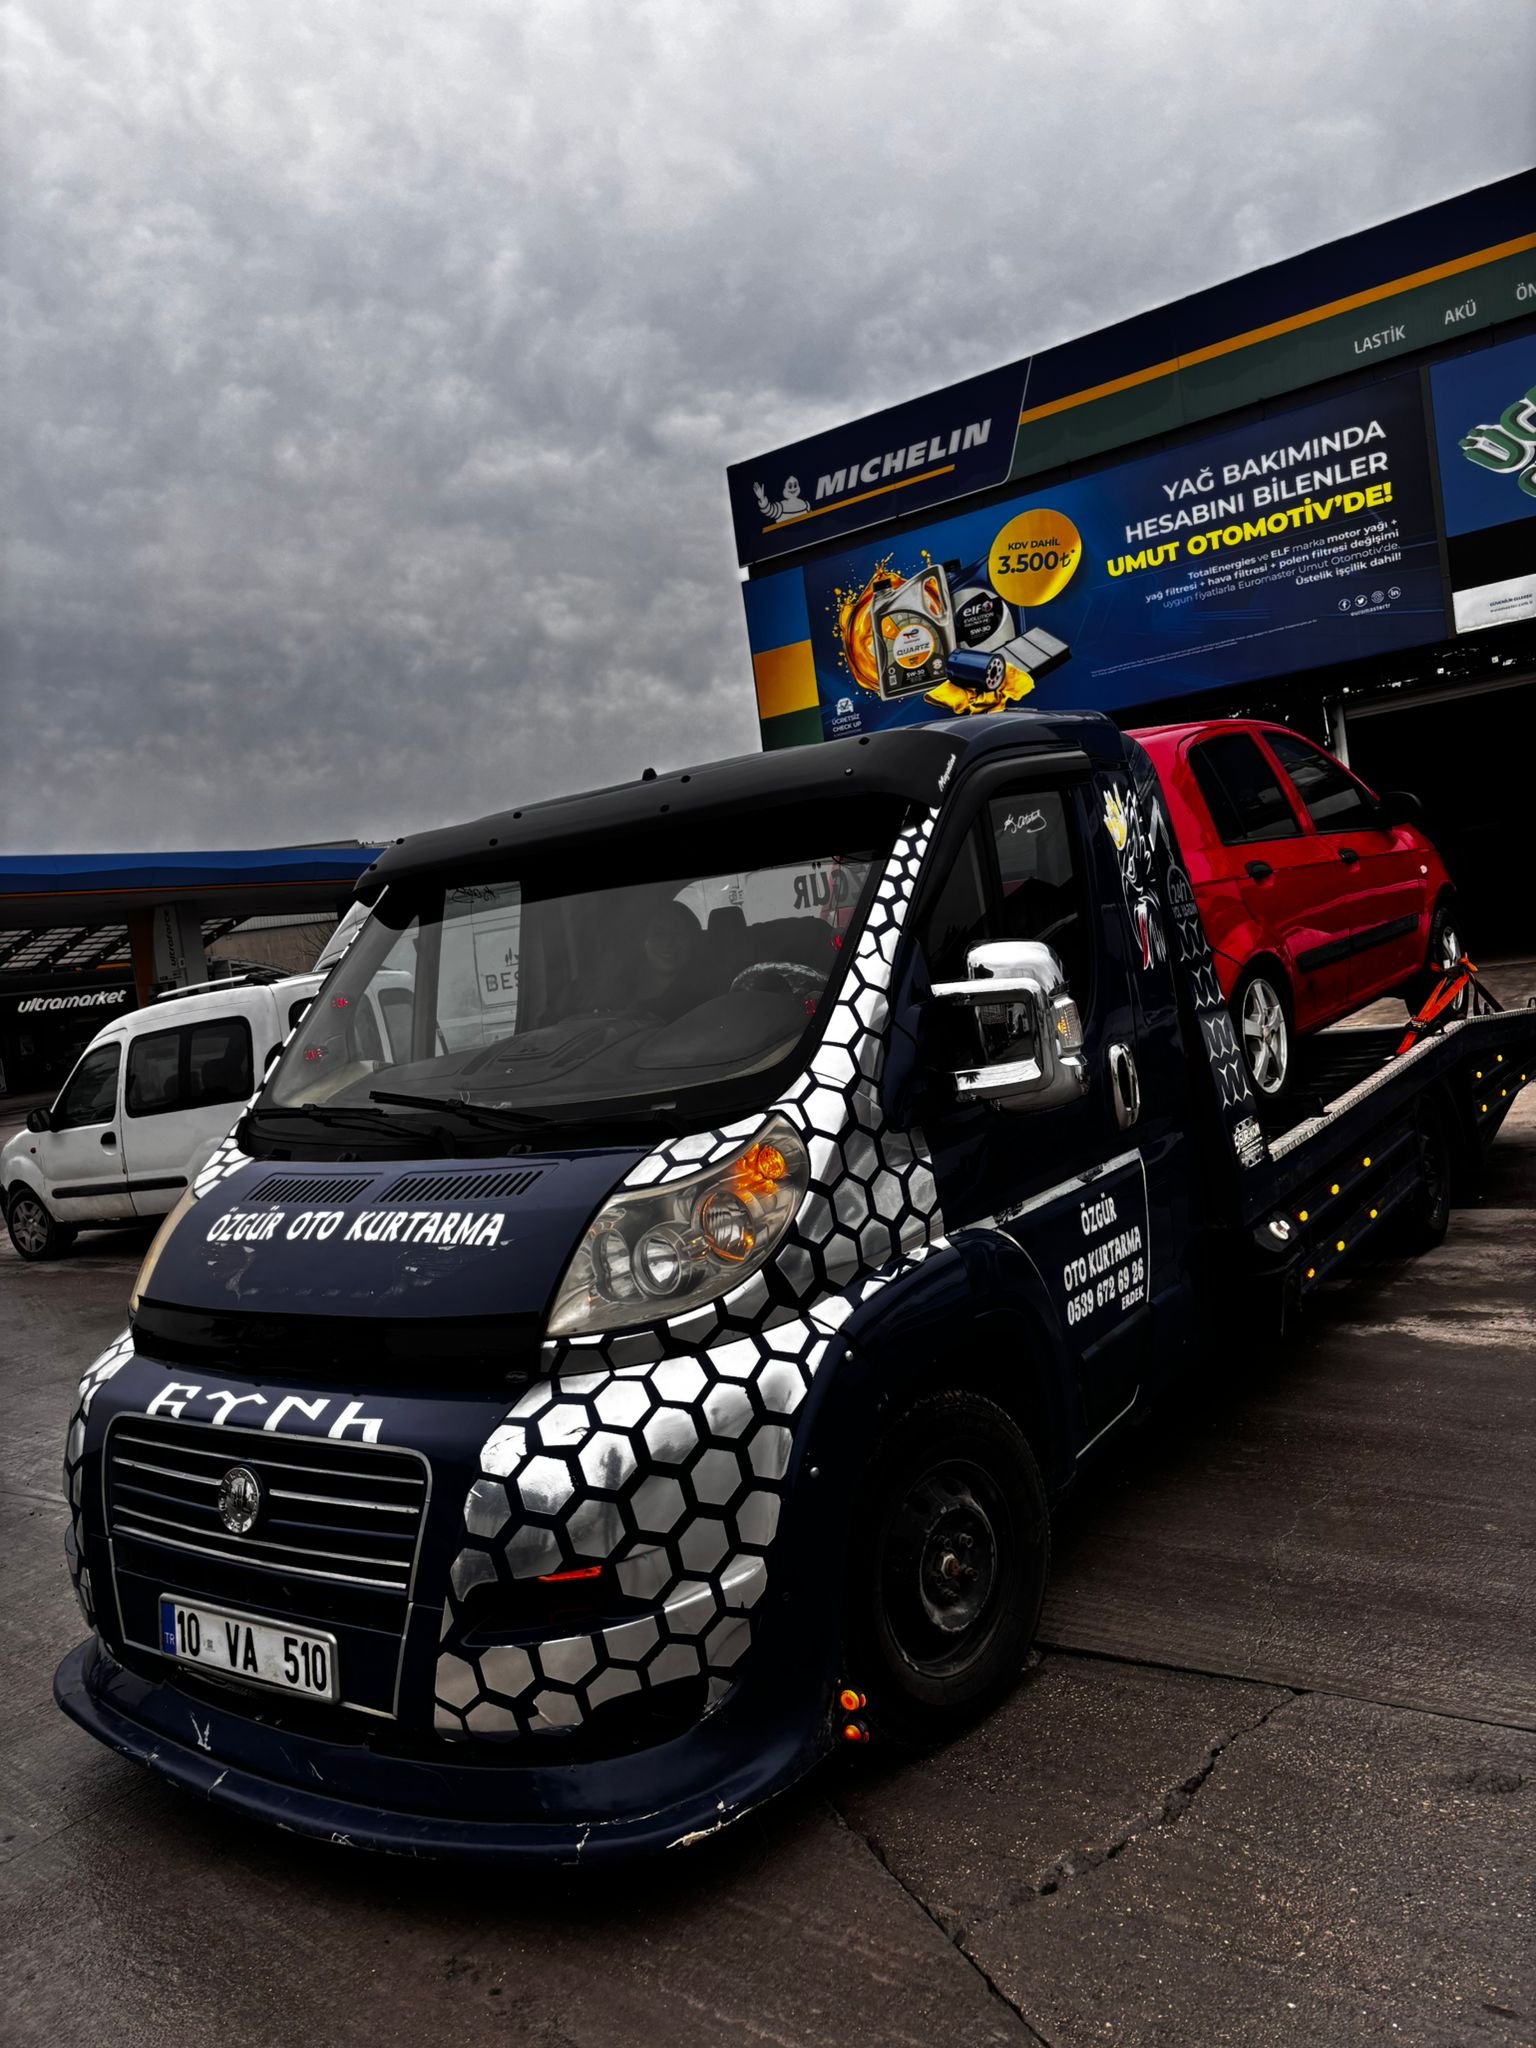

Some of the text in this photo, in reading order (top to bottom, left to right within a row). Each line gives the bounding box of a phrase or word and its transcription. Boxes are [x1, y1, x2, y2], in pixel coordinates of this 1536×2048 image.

[1444, 299, 1477, 325] AKÜ
[1354, 325, 1406, 354] LASTİK
[815, 418, 992, 500] MICHELIN
[1162, 420, 1386, 501] YAĞ BAKIMINDA
[1125, 451, 1389, 543] HESABINI BİLENLER
[1008, 537, 1060, 551] KDV DAHİL
[1107, 541, 1179, 577] UMUT
[1188, 557, 1256, 580] TotalEnergies
[1257, 553, 1269, 563] ve
[1271, 546, 1290, 559] ELF
[1292, 538, 1325, 552] marka
[1328, 530, 1361, 544] motor
[1363, 521, 1388, 539] yağı
[1145, 592, 1163, 604] yağ
[1165, 581, 1197, 597] filtresi
[1208, 574, 1232, 587] hava
[1234, 563, 1268, 580] filtresi
[1279, 554, 1309, 570] polen
[1312, 543, 1347, 559] filtresi
[1350, 529, 1399, 550] değişimi
[1163, 595, 1192, 609] uygun
[1195, 583, 1236, 601] fiyatlarla
[1238, 568, 1296, 590] Euromaster
[1298, 561, 1329, 575] Umut
[1295, 569, 1333, 586] Üstelik
[963, 604, 983, 618] elf
[896, 642, 931, 656] QUARTZ
[17, 989, 127, 1014] ultramarket
[207, 1205, 506, 1246] ÖZGÜR OTO KURTARMA
[1081, 1192, 1117, 1236] ÖZGÜR
[1064, 1226, 1142, 1291] OTO KURTARMA
[1067, 1257, 1144, 1326] 0539 672 69 26
[1121, 1284, 1145, 1311] ERDEK
[164, 1632, 175, 1646] TR
[177, 1610, 328, 1692] 10 VA 510
